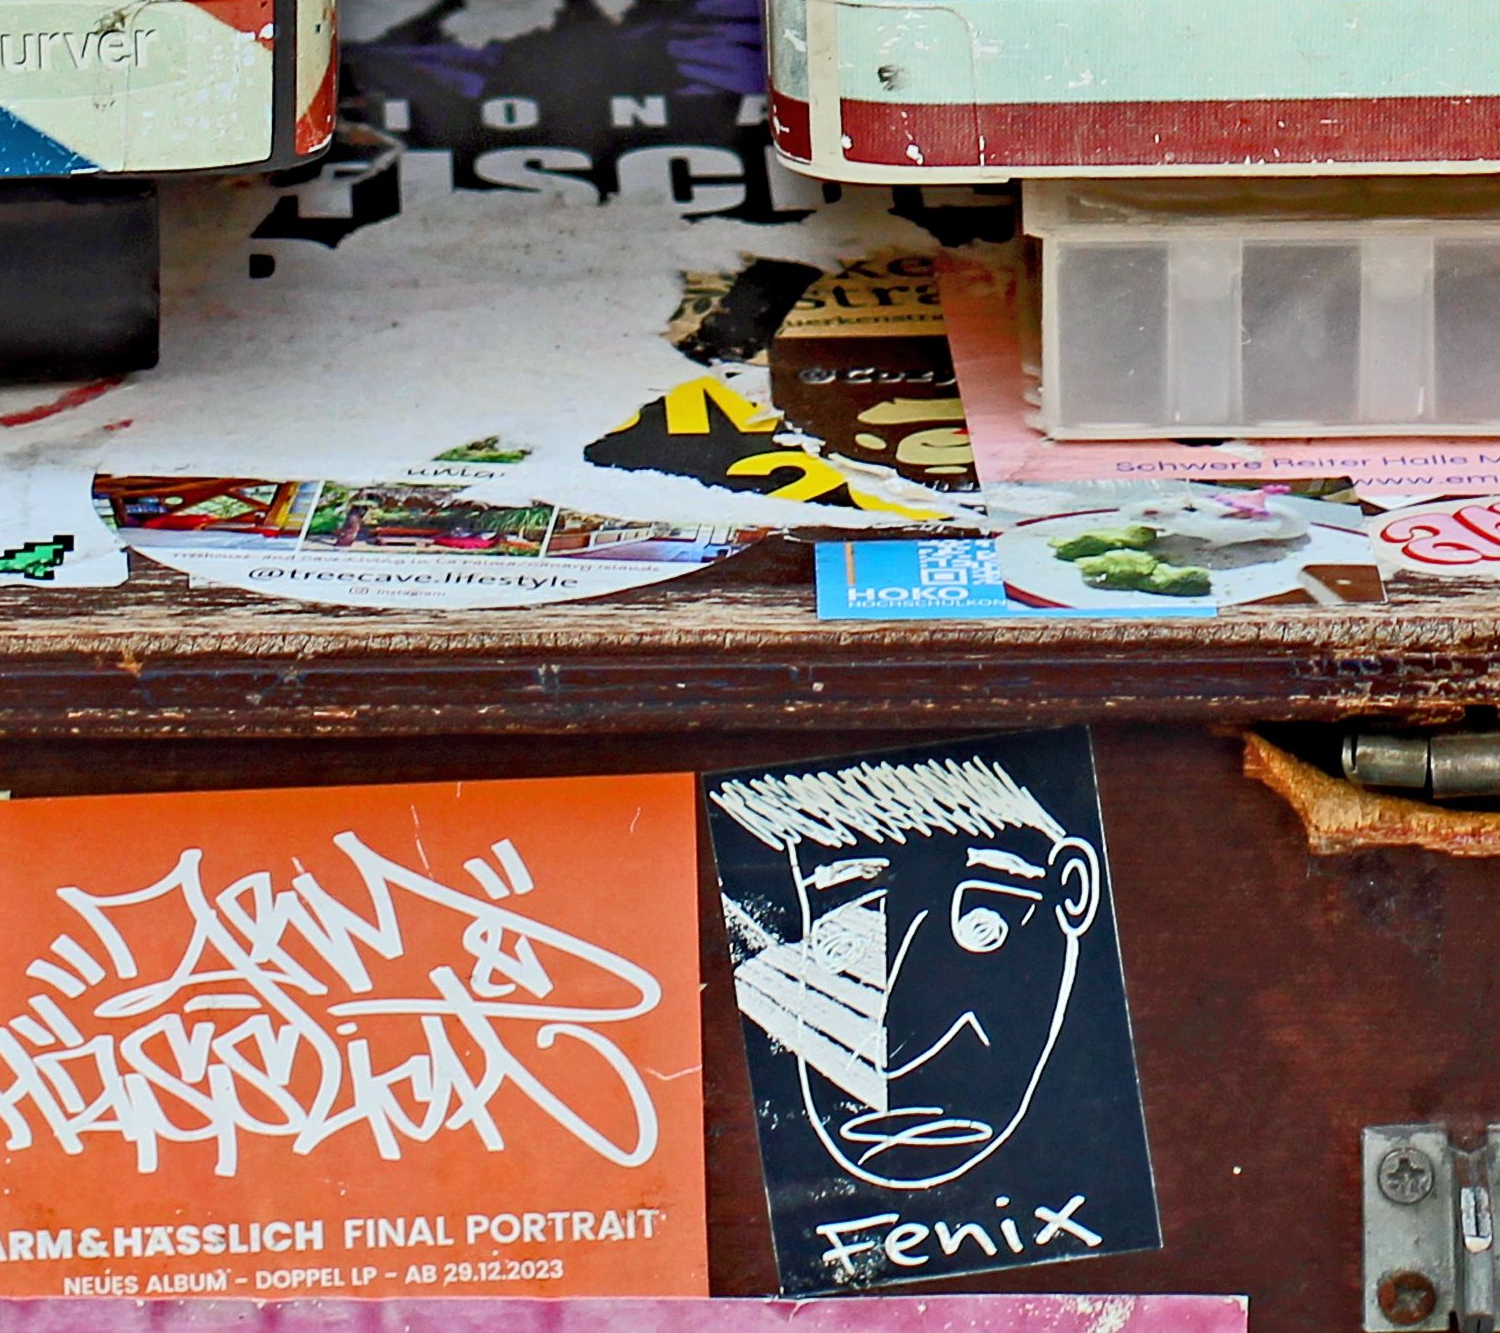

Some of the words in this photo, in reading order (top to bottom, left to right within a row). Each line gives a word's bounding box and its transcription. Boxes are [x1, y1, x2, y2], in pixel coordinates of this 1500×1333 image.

[1115, 457, 1263, 473] Schwere
[1272, 454, 1373, 471] Reiter
[1381, 452, 1469, 468] Halle
[247, 566, 580, 591] @treecave.lifestyle
[847, 586, 970, 601] HOKO
[342, 1215, 455, 1251] FINAL
[465, 1207, 660, 1245] PORTRAIT
[814, 1194, 1104, 1277] Fenix
[63, 1272, 141, 1297] NEUES
[145, 1270, 230, 1294] ALBUM
[255, 1265, 346, 1290] DOPPEL
[350, 1264, 379, 1288] LP
[404, 1262, 438, 1284] AB
[442, 1257, 565, 1285] 29.12.2023
